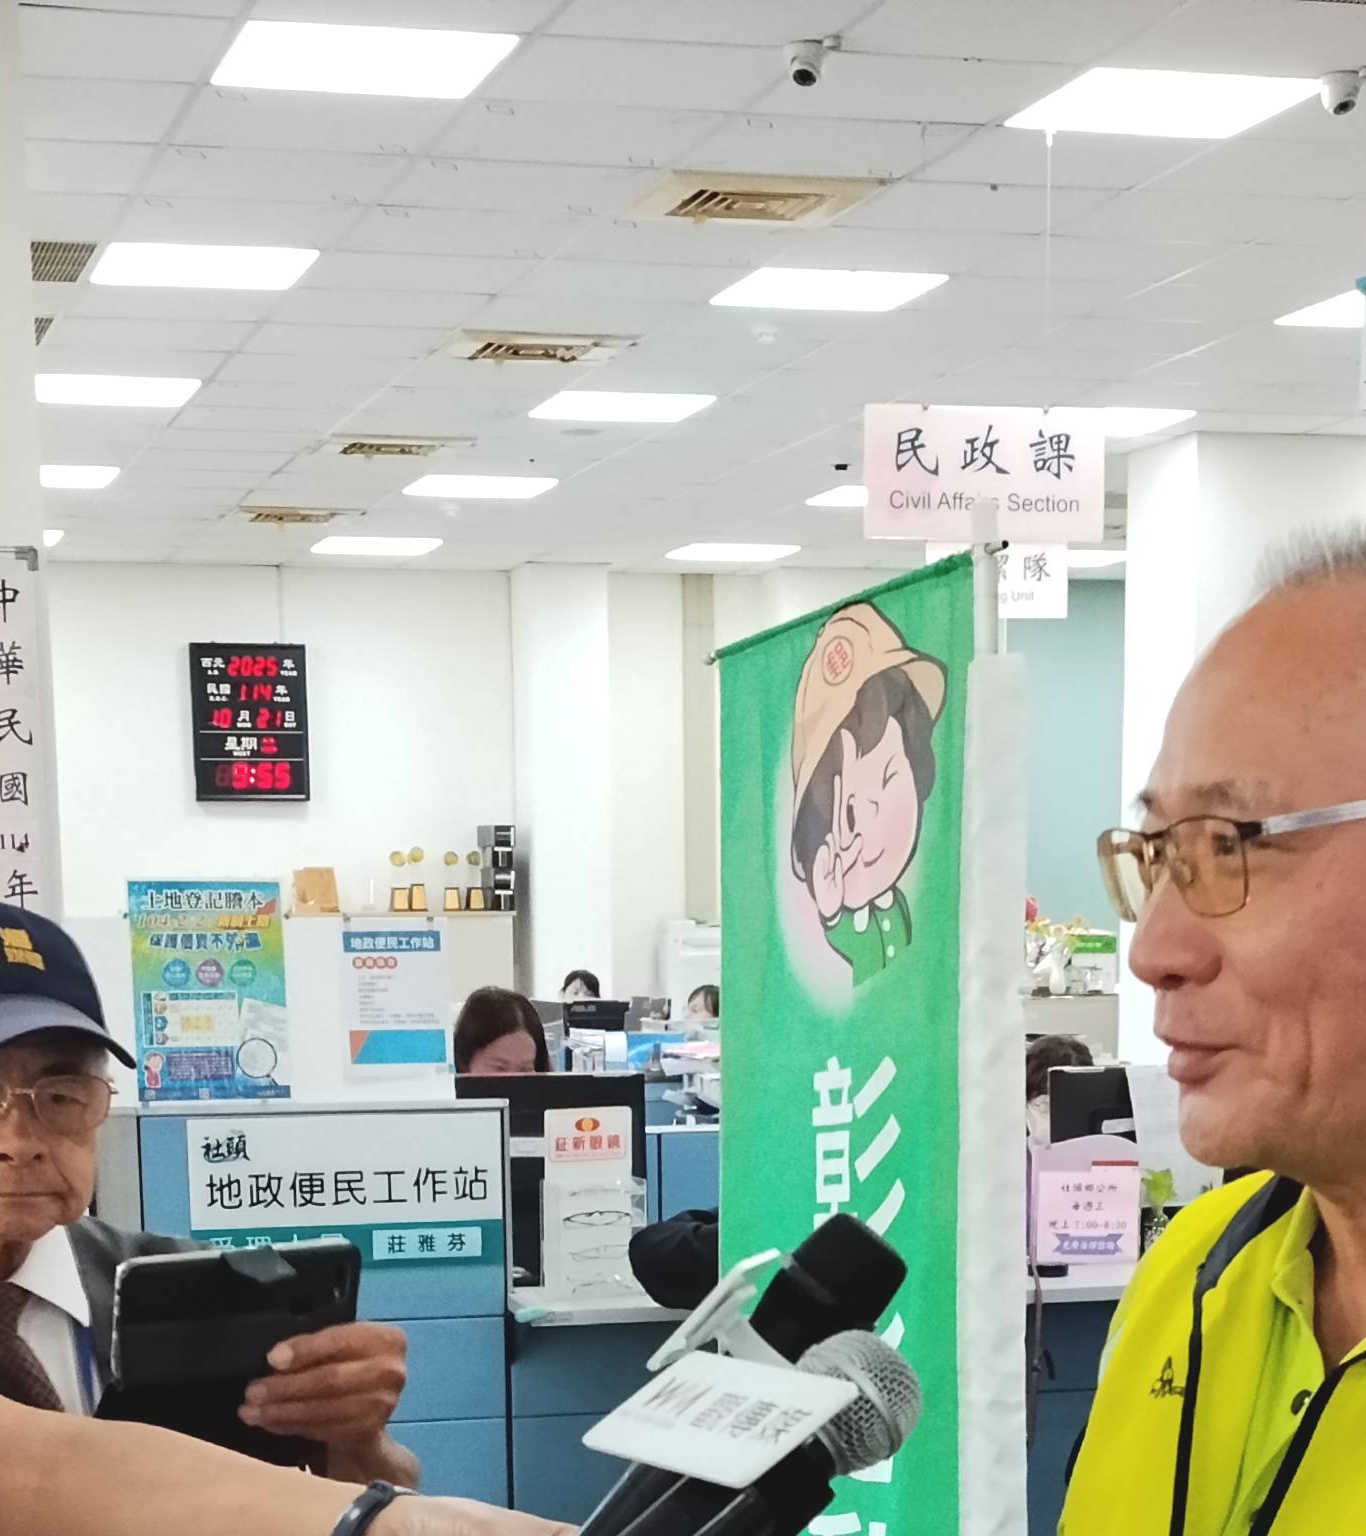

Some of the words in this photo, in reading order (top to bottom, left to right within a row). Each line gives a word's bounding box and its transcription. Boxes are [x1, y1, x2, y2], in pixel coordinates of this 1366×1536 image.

[894, 425, 1076, 480] 民政課
[889, 491, 931, 510] Civil
[937, 491, 1000, 511] Affas
[1006, 493, 1080, 513] Section
[227, 655, 280, 677] 2025
[350, 936, 435, 950] 地政便民工作站
[205, 1166, 488, 1210] 地政便民工作站
[387, 1232, 467, 1254] 莊雅芬
